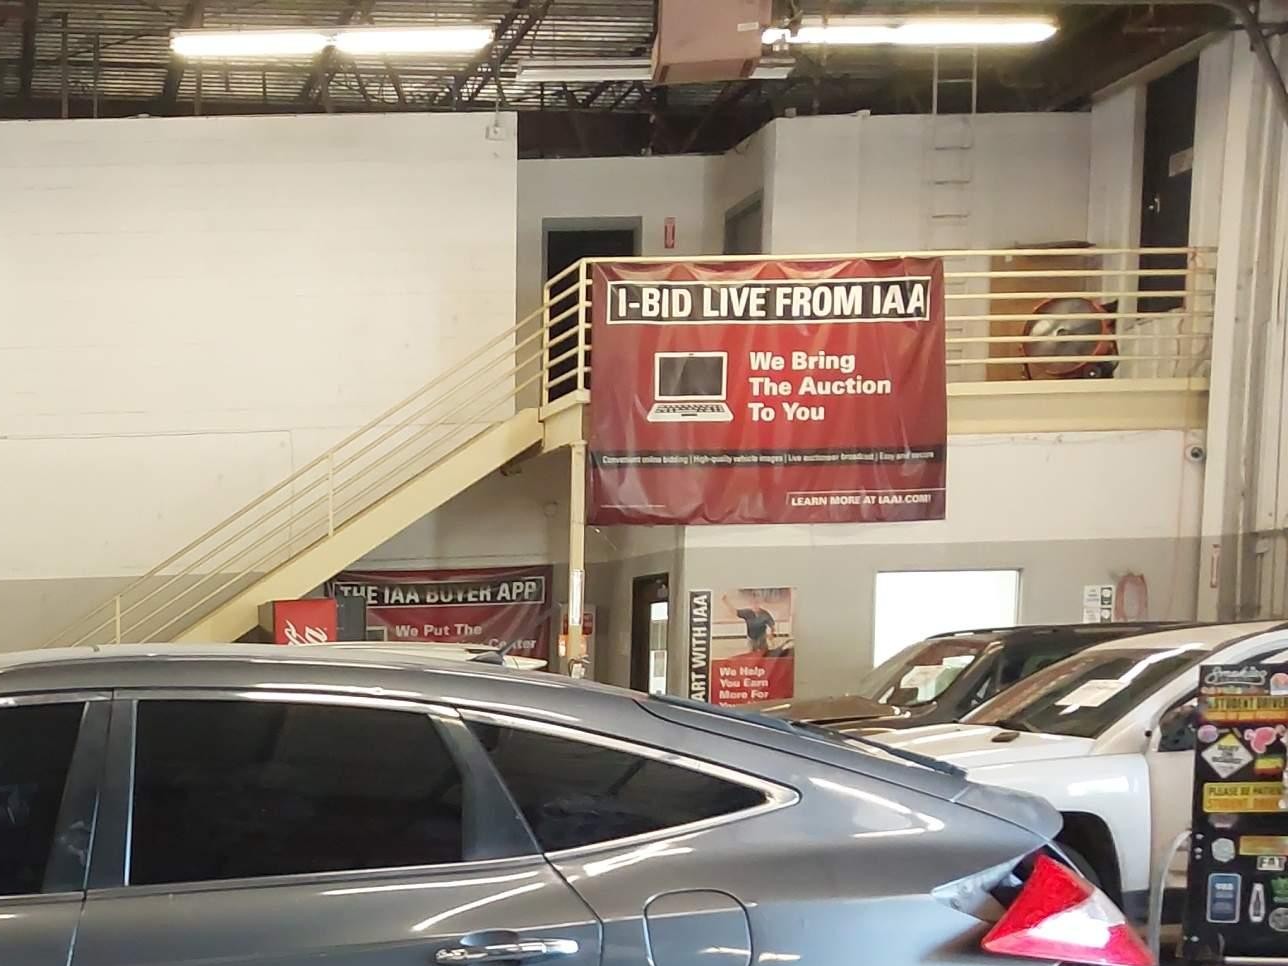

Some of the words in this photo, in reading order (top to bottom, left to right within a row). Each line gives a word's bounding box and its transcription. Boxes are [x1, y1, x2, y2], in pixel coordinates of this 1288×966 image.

[618, 287, 692, 318] I-BID
[702, 287, 768, 318] LIVE
[775, 285, 863, 317] FROM
[872, 283, 925, 315] IAA
[749, 351, 785, 371] We
[791, 350, 856, 374] Bring
[748, 377, 792, 396] The
[798, 375, 892, 396] Auction
[747, 402, 776, 422] To
[782, 401, 825, 421] You
[791, 496, 828, 506] LEARN
[830, 495, 861, 505] MORE
[863, 495, 876, 504] AT
[384, 586, 420, 604] IAA
[497, 581, 537, 601] APP
[692, 594, 708, 623] IAA
[395, 624, 419, 638] We
[423, 623, 450, 637] Put
[454, 623, 483, 636] The
[488, 638, 537, 650] Ceter
[691, 626, 708, 669] WITH
[719, 667, 737, 677] We
[739, 666, 766, 677] Help
[690, 671, 707, 703] ART
[720, 678, 741, 688] You
[743, 677, 769, 688] Earn
[718, 690, 748, 700] More
[751, 689, 769, 699] For
